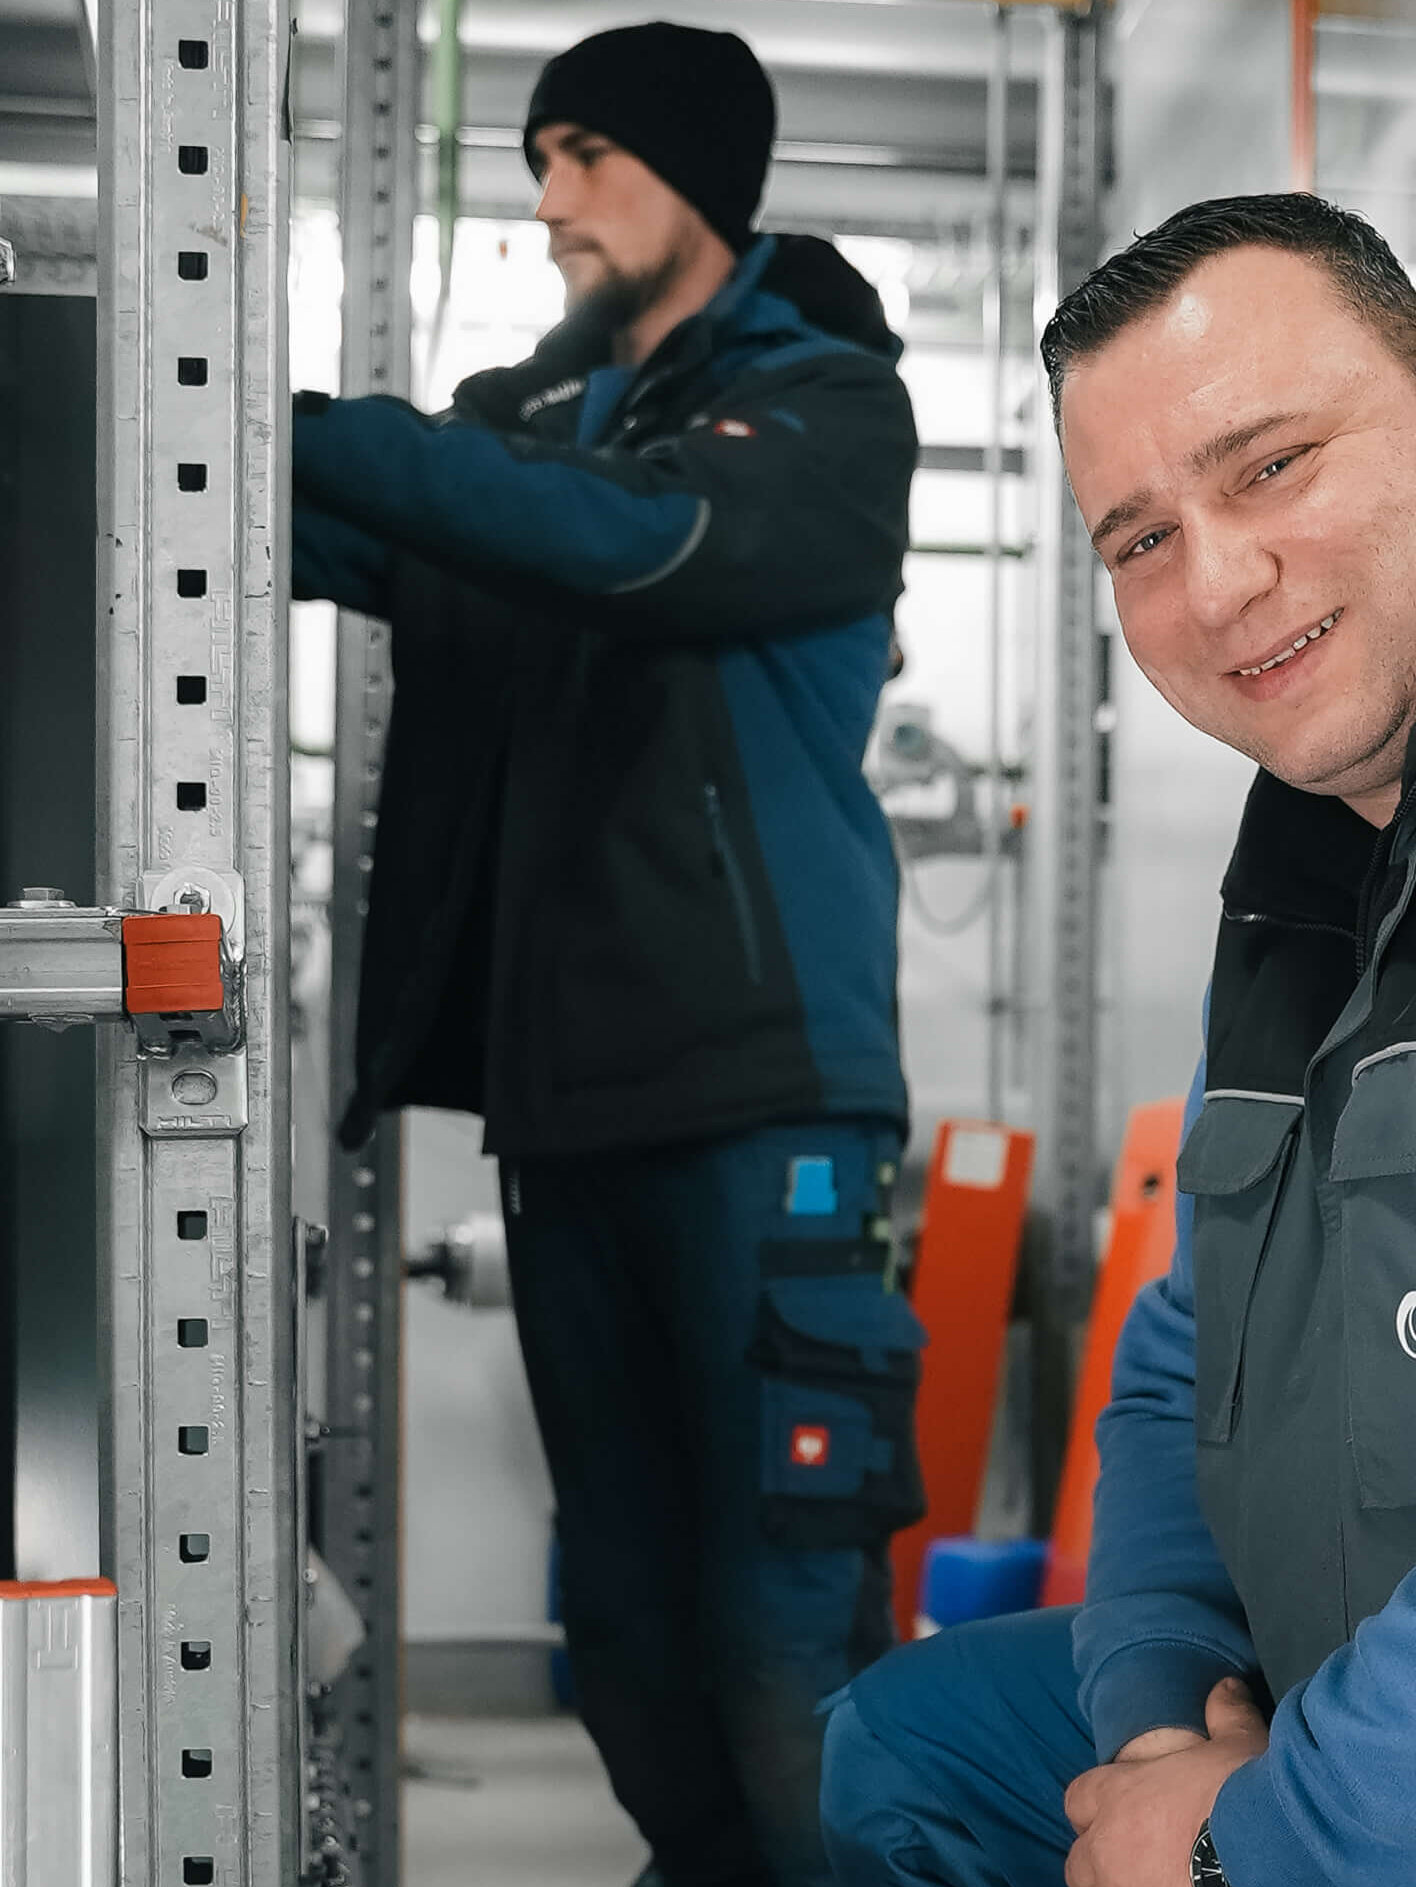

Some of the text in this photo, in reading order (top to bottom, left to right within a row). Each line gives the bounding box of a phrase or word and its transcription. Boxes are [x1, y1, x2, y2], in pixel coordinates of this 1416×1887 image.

[208, 591, 234, 723] HILTI
[155, 1113, 232, 1131] HILTI
[209, 1194, 235, 1332] HILTI
